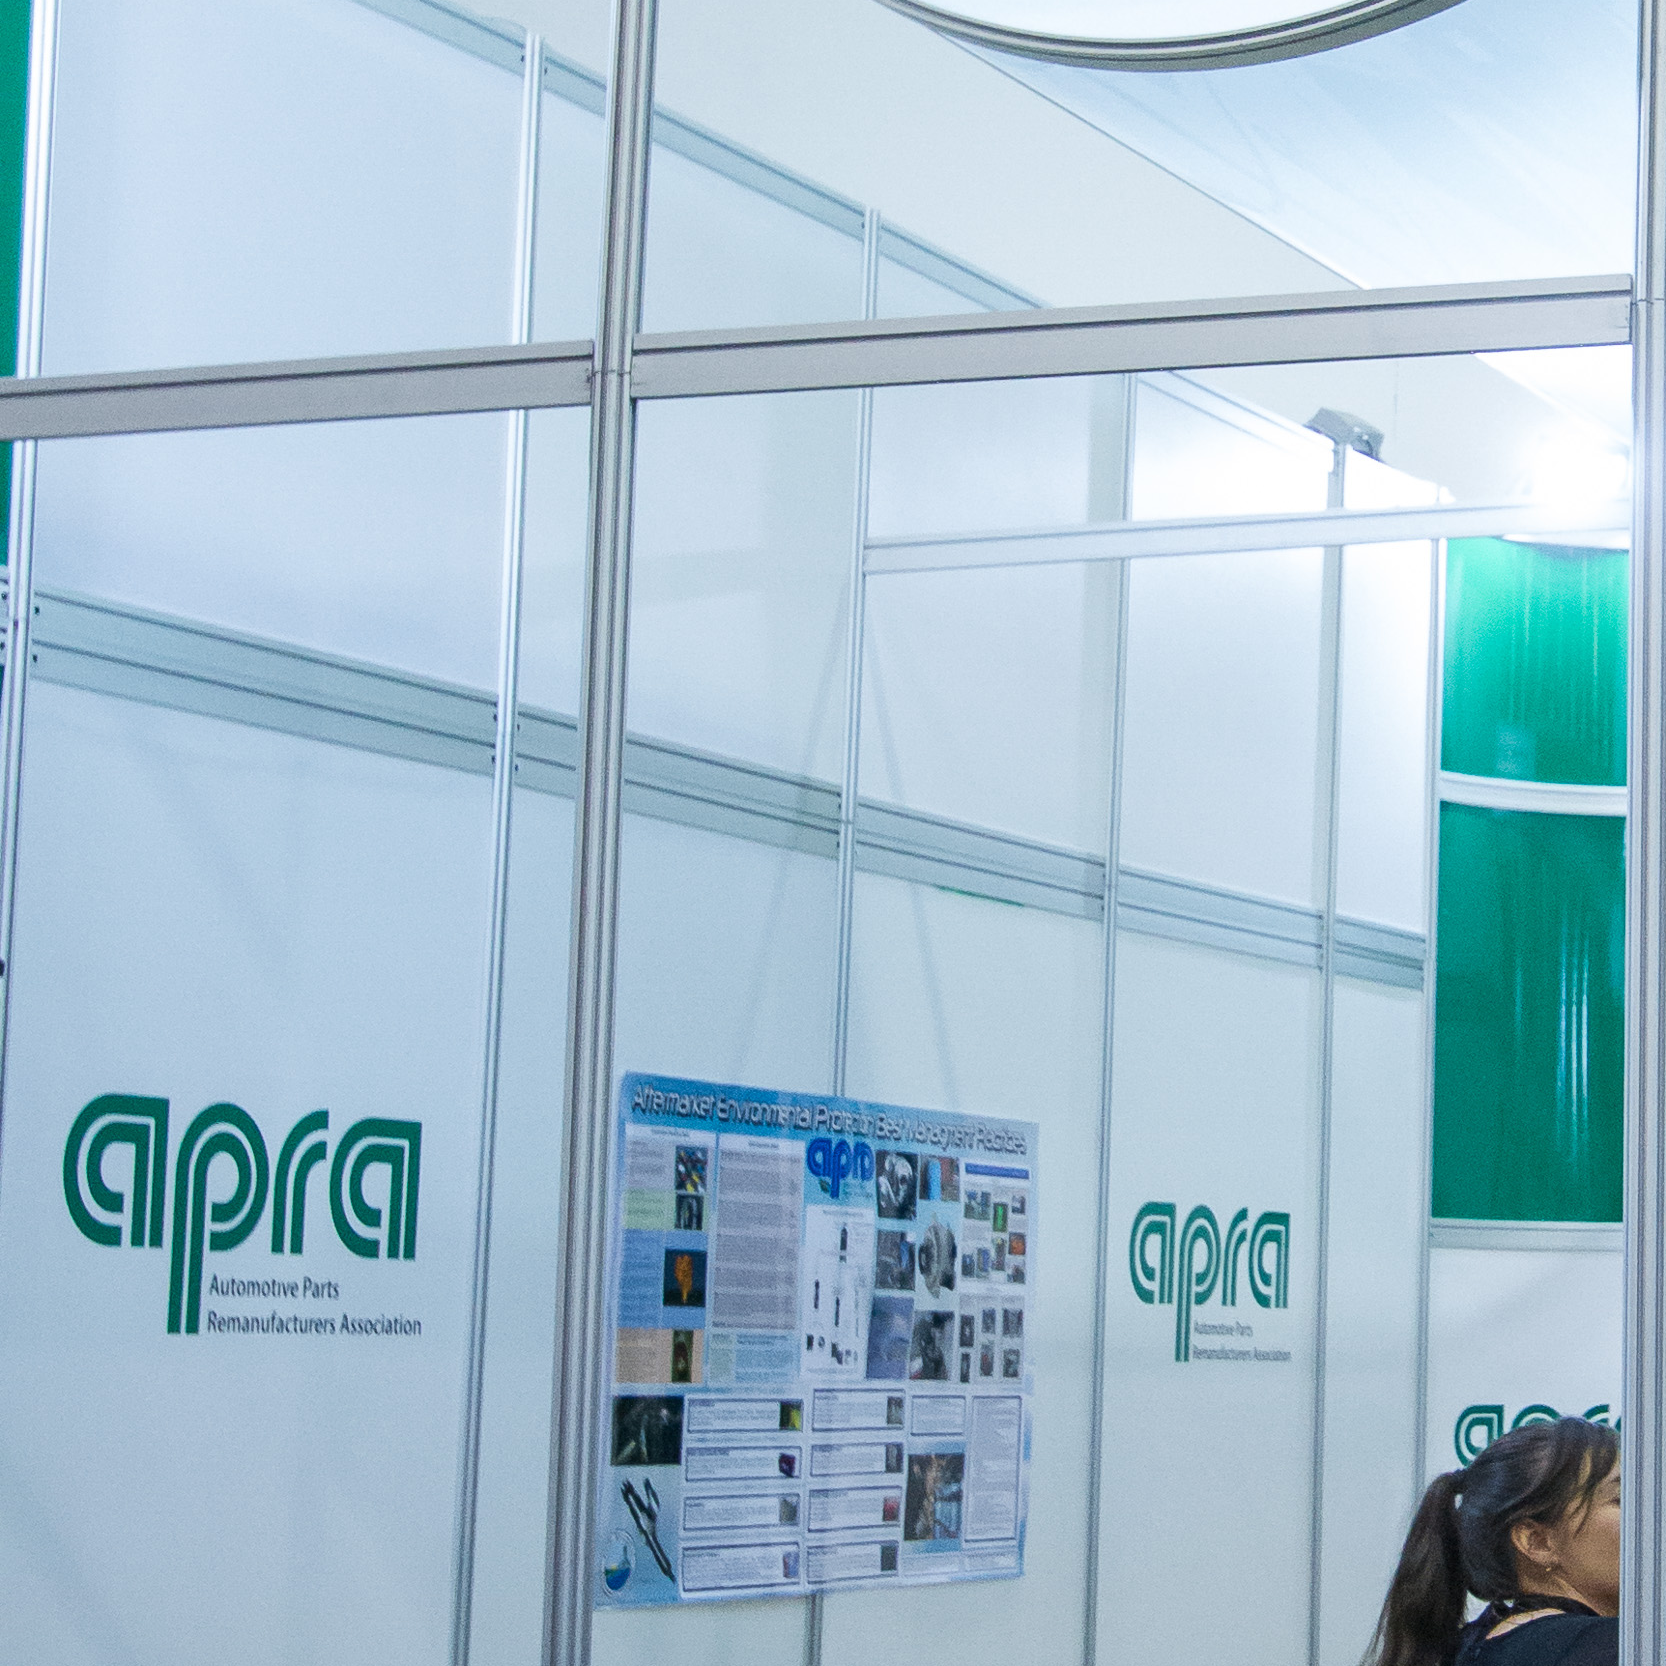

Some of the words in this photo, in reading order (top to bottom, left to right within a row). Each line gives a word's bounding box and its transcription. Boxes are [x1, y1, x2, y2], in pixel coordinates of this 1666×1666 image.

[63, 1092, 422, 1334] apra
[207, 1309, 336, 1334] Remanufacturers
[340, 1312, 422, 1336] Association
[209, 1273, 299, 1298] Automotive
[303, 1276, 340, 1300] Parts
[1129, 1201, 1291, 1363] apra
